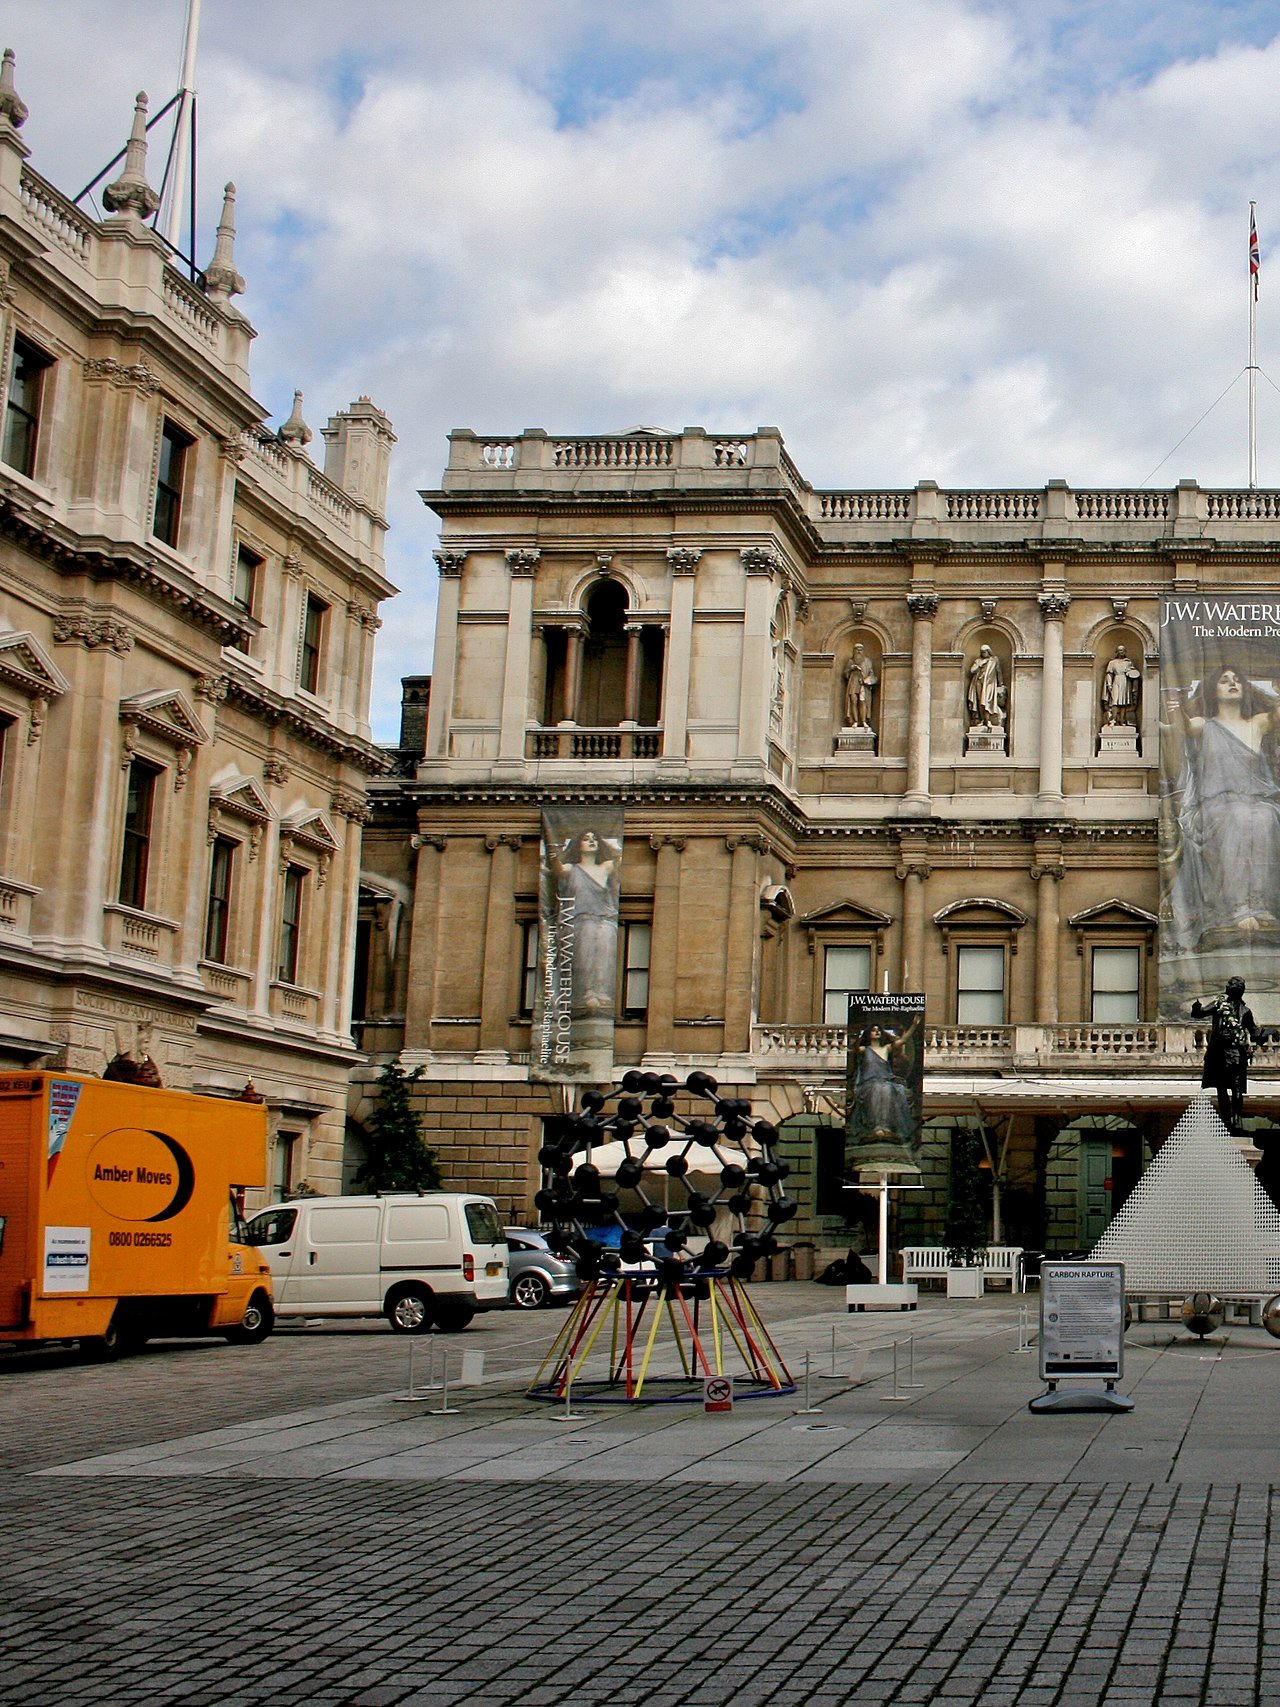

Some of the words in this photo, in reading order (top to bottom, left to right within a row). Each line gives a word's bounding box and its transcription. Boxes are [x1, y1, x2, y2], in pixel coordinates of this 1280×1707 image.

[1161, 602, 1200, 627] J.W.
[1192, 625, 1214, 637] The
[1217, 625, 1262, 637] Modern
[556, 895, 576, 929] J.W.
[548, 925, 557, 943] The
[545, 946, 557, 987] Modern
[555, 933, 574, 1064] WATERHOUSE
[850, 995, 865, 1007] J.W.
[867, 995, 925, 1006] WATERHOUSE
[540, 990, 555, 1064] Pre-Raphaelite
[94, 1164, 133, 1182] Amber
[136, 1167, 172, 1185] Moves
[109, 1232, 132, 1247] 0800
[134, 1232, 172, 1247] 0266525
